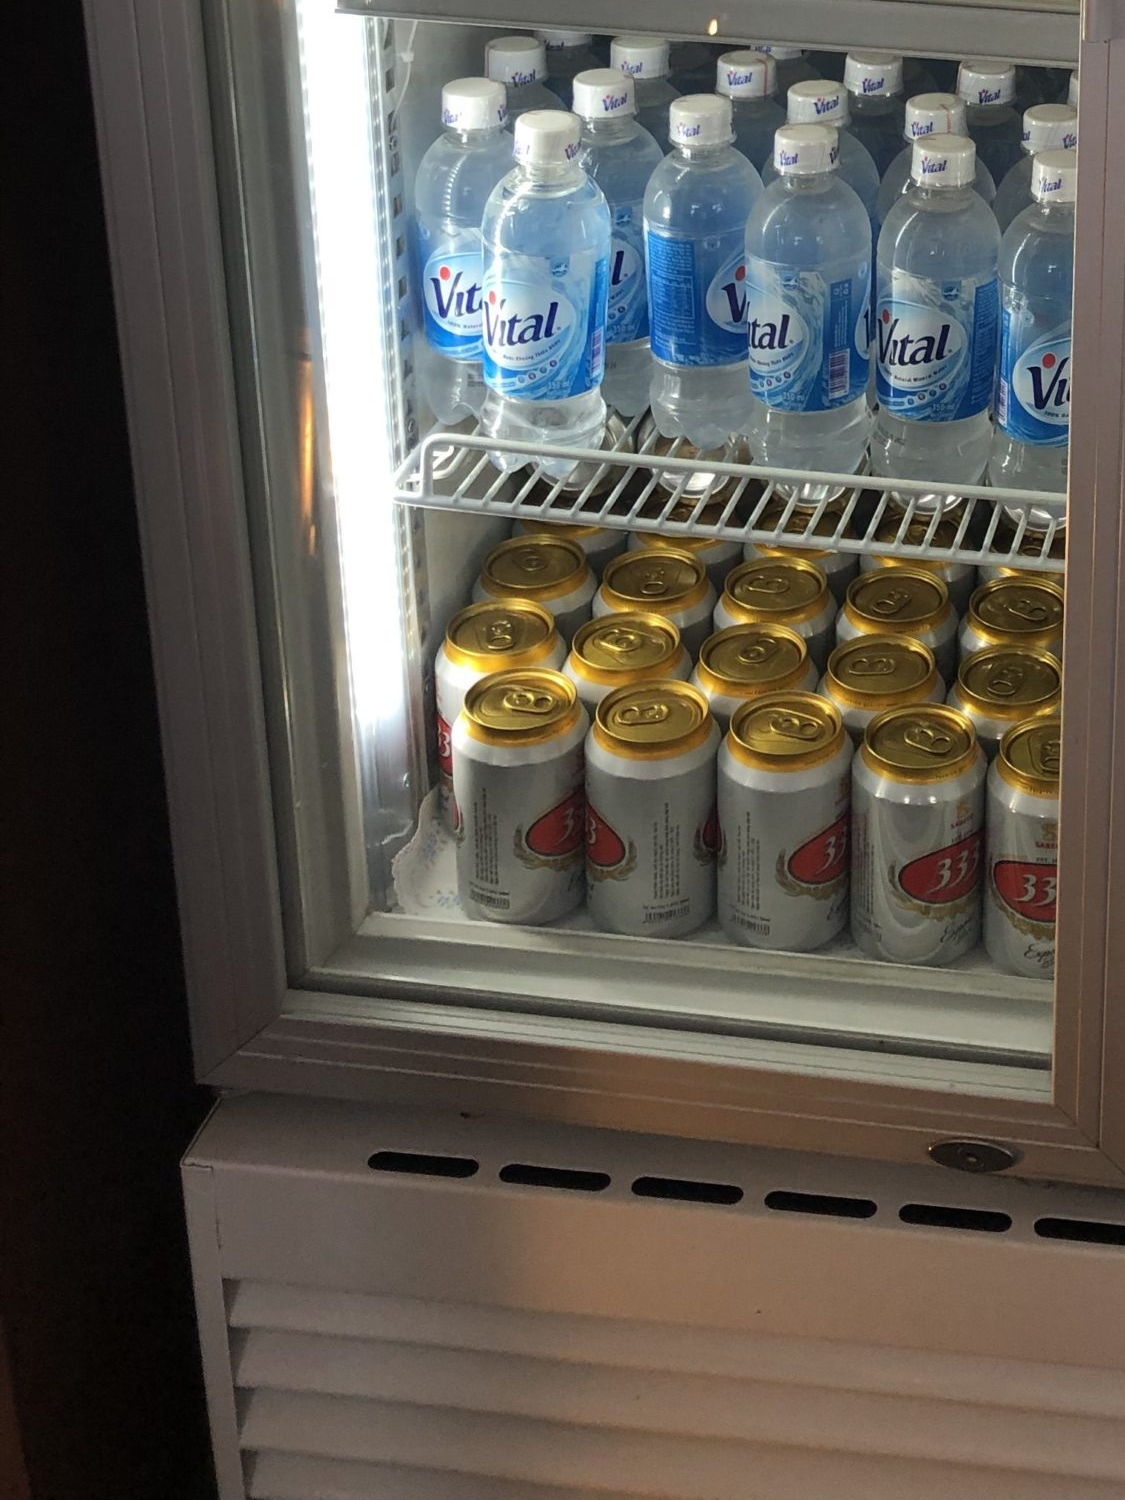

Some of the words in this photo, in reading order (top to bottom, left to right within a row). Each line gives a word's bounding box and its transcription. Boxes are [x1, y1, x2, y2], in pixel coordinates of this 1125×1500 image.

[512, 69, 536, 87] Vital
[727, 70, 753, 86] Vital
[862, 77, 885, 93] Vital
[602, 93, 628, 112] Vital
[814, 96, 840, 115] Vital
[979, 88, 1001, 105] Vital
[911, 121, 934, 137] Vital
[779, 150, 799, 166] Vital
[921, 156, 948, 175] Vital
[430, 266, 484, 319] Vit
[484, 291, 560, 347] Vital
[749, 314, 791, 350] tal
[877, 309, 951, 366] Vital
[1015, 874, 1057, 907] 33
